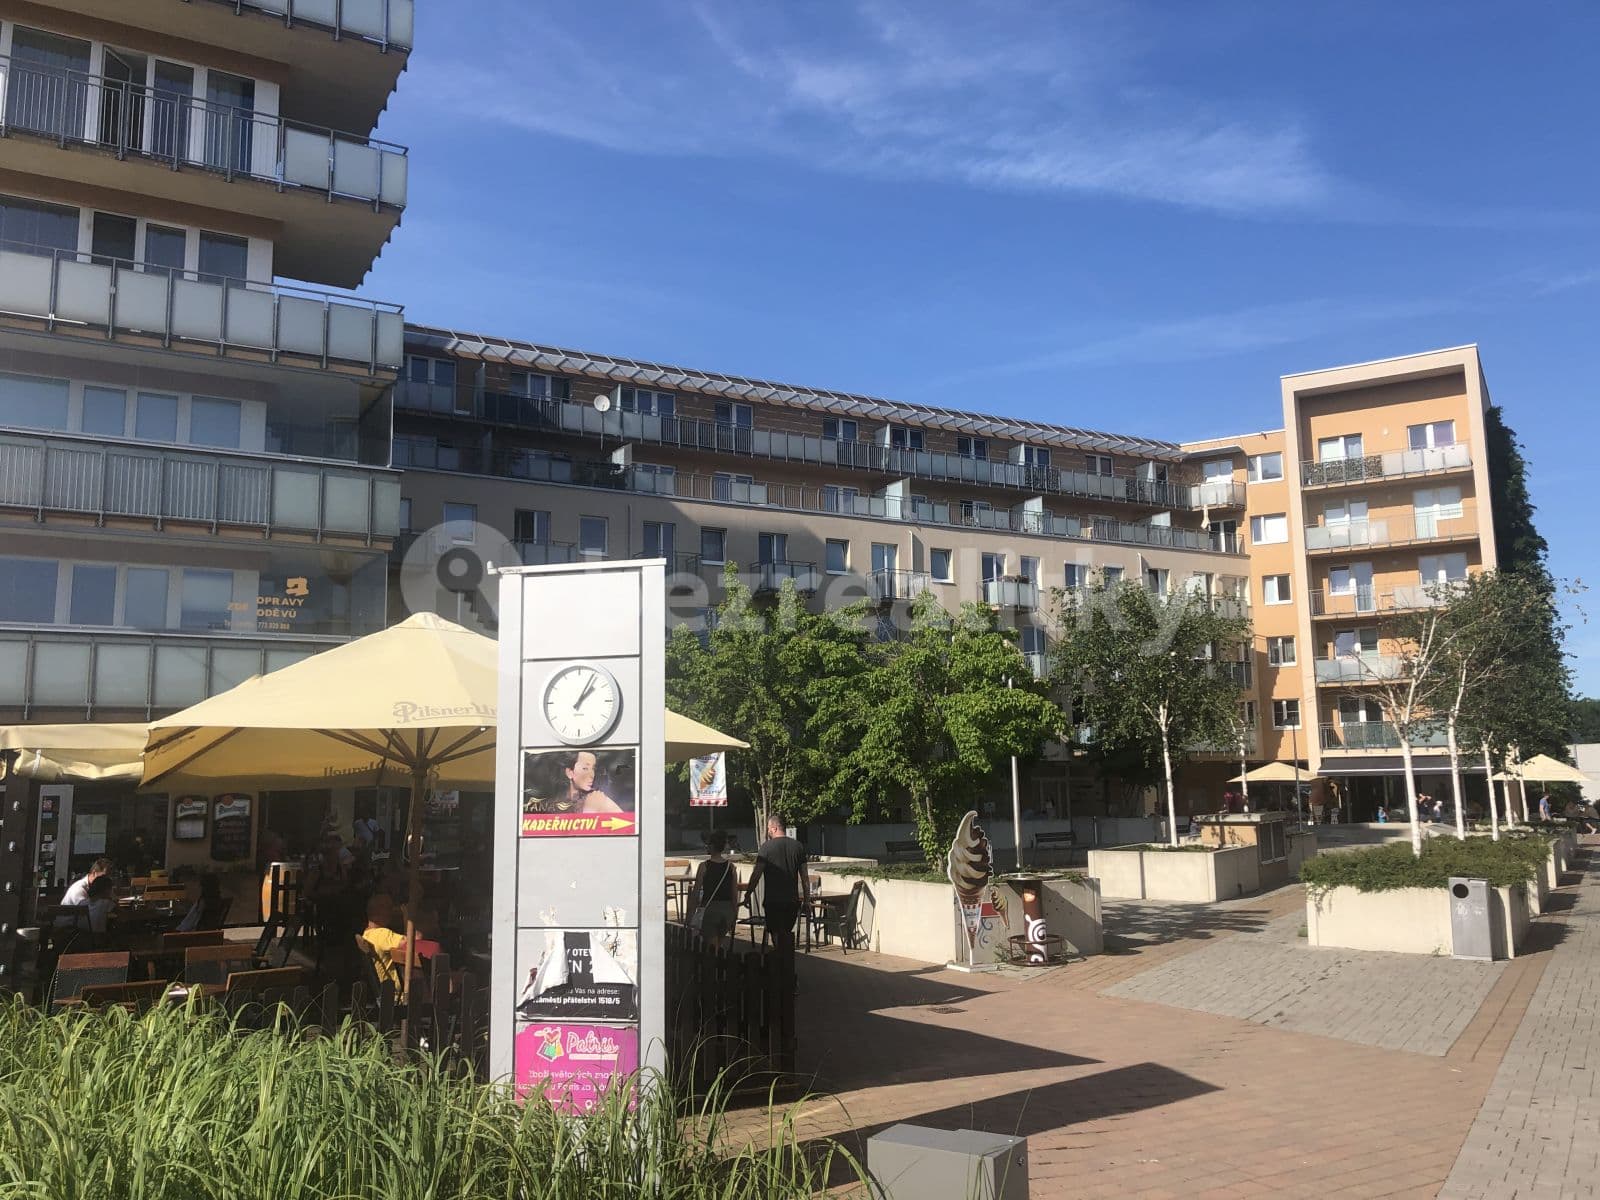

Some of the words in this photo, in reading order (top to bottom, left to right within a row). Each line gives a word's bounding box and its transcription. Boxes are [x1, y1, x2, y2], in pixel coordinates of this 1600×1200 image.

[256, 596, 304, 606] OPRAVY
[256, 608, 297, 618] ODĚVŮ
[392, 701, 474, 724] Pilsner
[522, 816, 599, 832] KADEŘNICTVÍ
[567, 1030, 619, 1054] Patris
